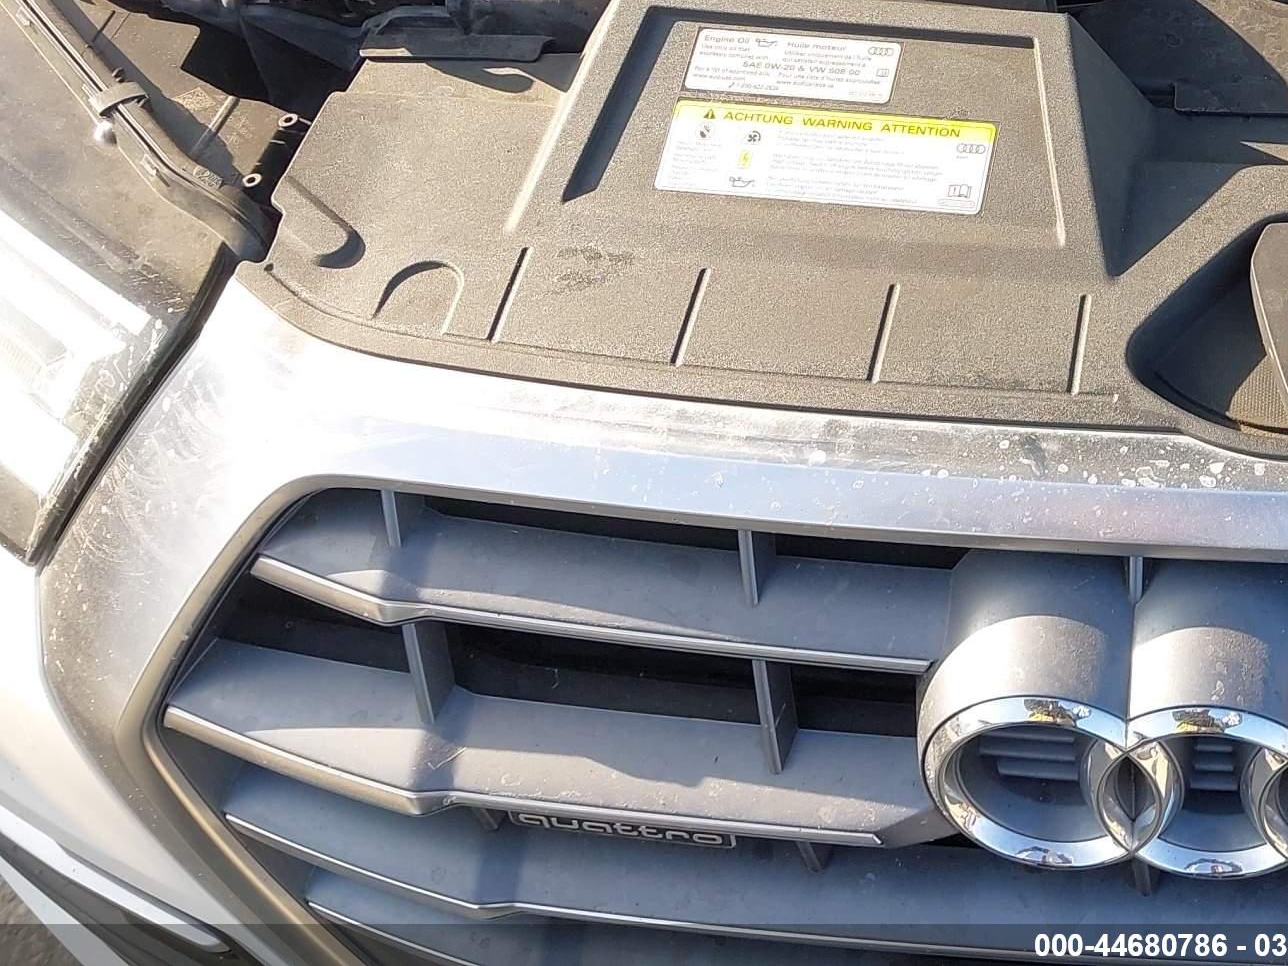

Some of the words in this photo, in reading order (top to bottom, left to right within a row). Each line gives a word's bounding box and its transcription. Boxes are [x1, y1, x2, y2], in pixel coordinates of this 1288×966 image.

[704, 34, 735, 43] Engine
[737, 36, 750, 44] Oil
[787, 41, 811, 49] Huile
[812, 43, 847, 51] moteur
[742, 61, 762, 69] SAE
[765, 63, 795, 71] 0W-20
[723, 111, 794, 125] ACHTUNG
[802, 117, 873, 131] WARNING
[880, 124, 961, 138] ATTENTION
[518, 813, 723, 844] quattro
